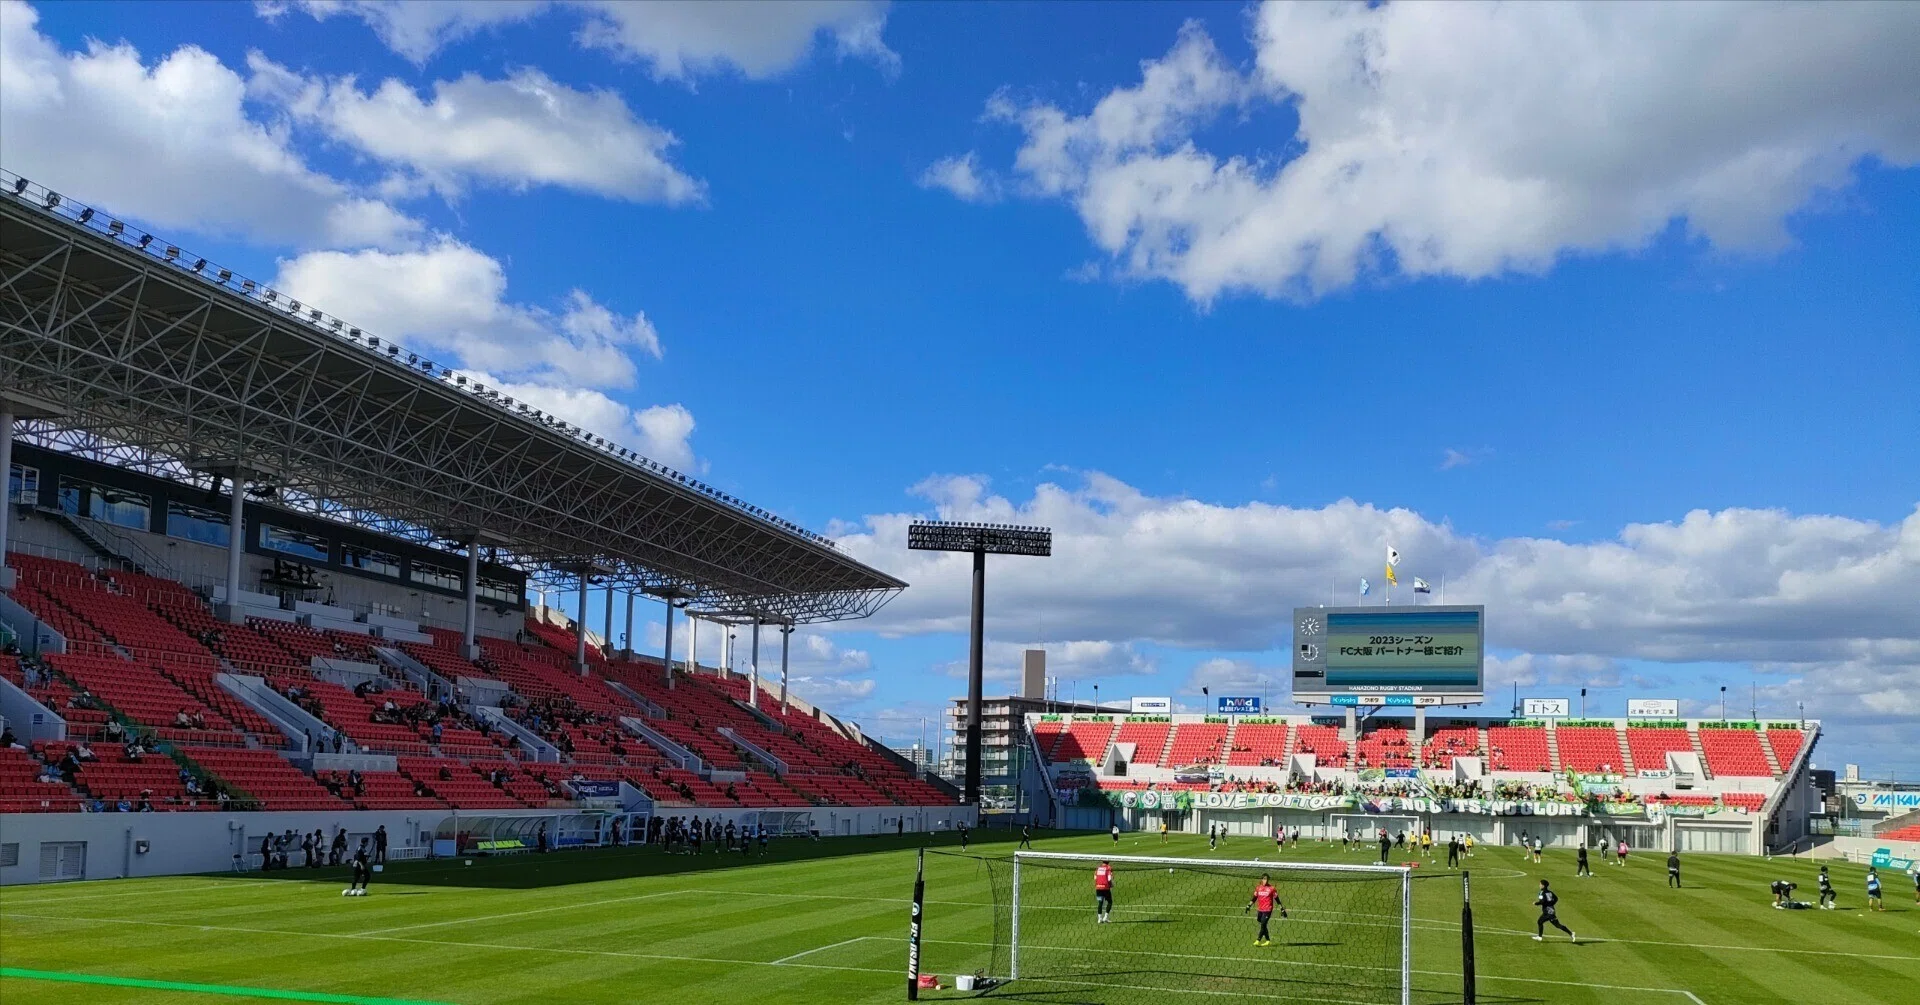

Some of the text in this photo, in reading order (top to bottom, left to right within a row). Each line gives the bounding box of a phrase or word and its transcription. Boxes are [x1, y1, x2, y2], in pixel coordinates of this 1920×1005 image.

[1369, 636, 1434, 645] 2023シーズン
[1340, 646, 1464, 656] FC大阪 パートナー様ご紹介
[1529, 703, 1561, 714] エトス
[1194, 793, 1249, 809] LOVE
[1401, 798, 1426, 812] NO
[1490, 801, 1517, 816] NO
[1520, 801, 1585, 817] GLORY
